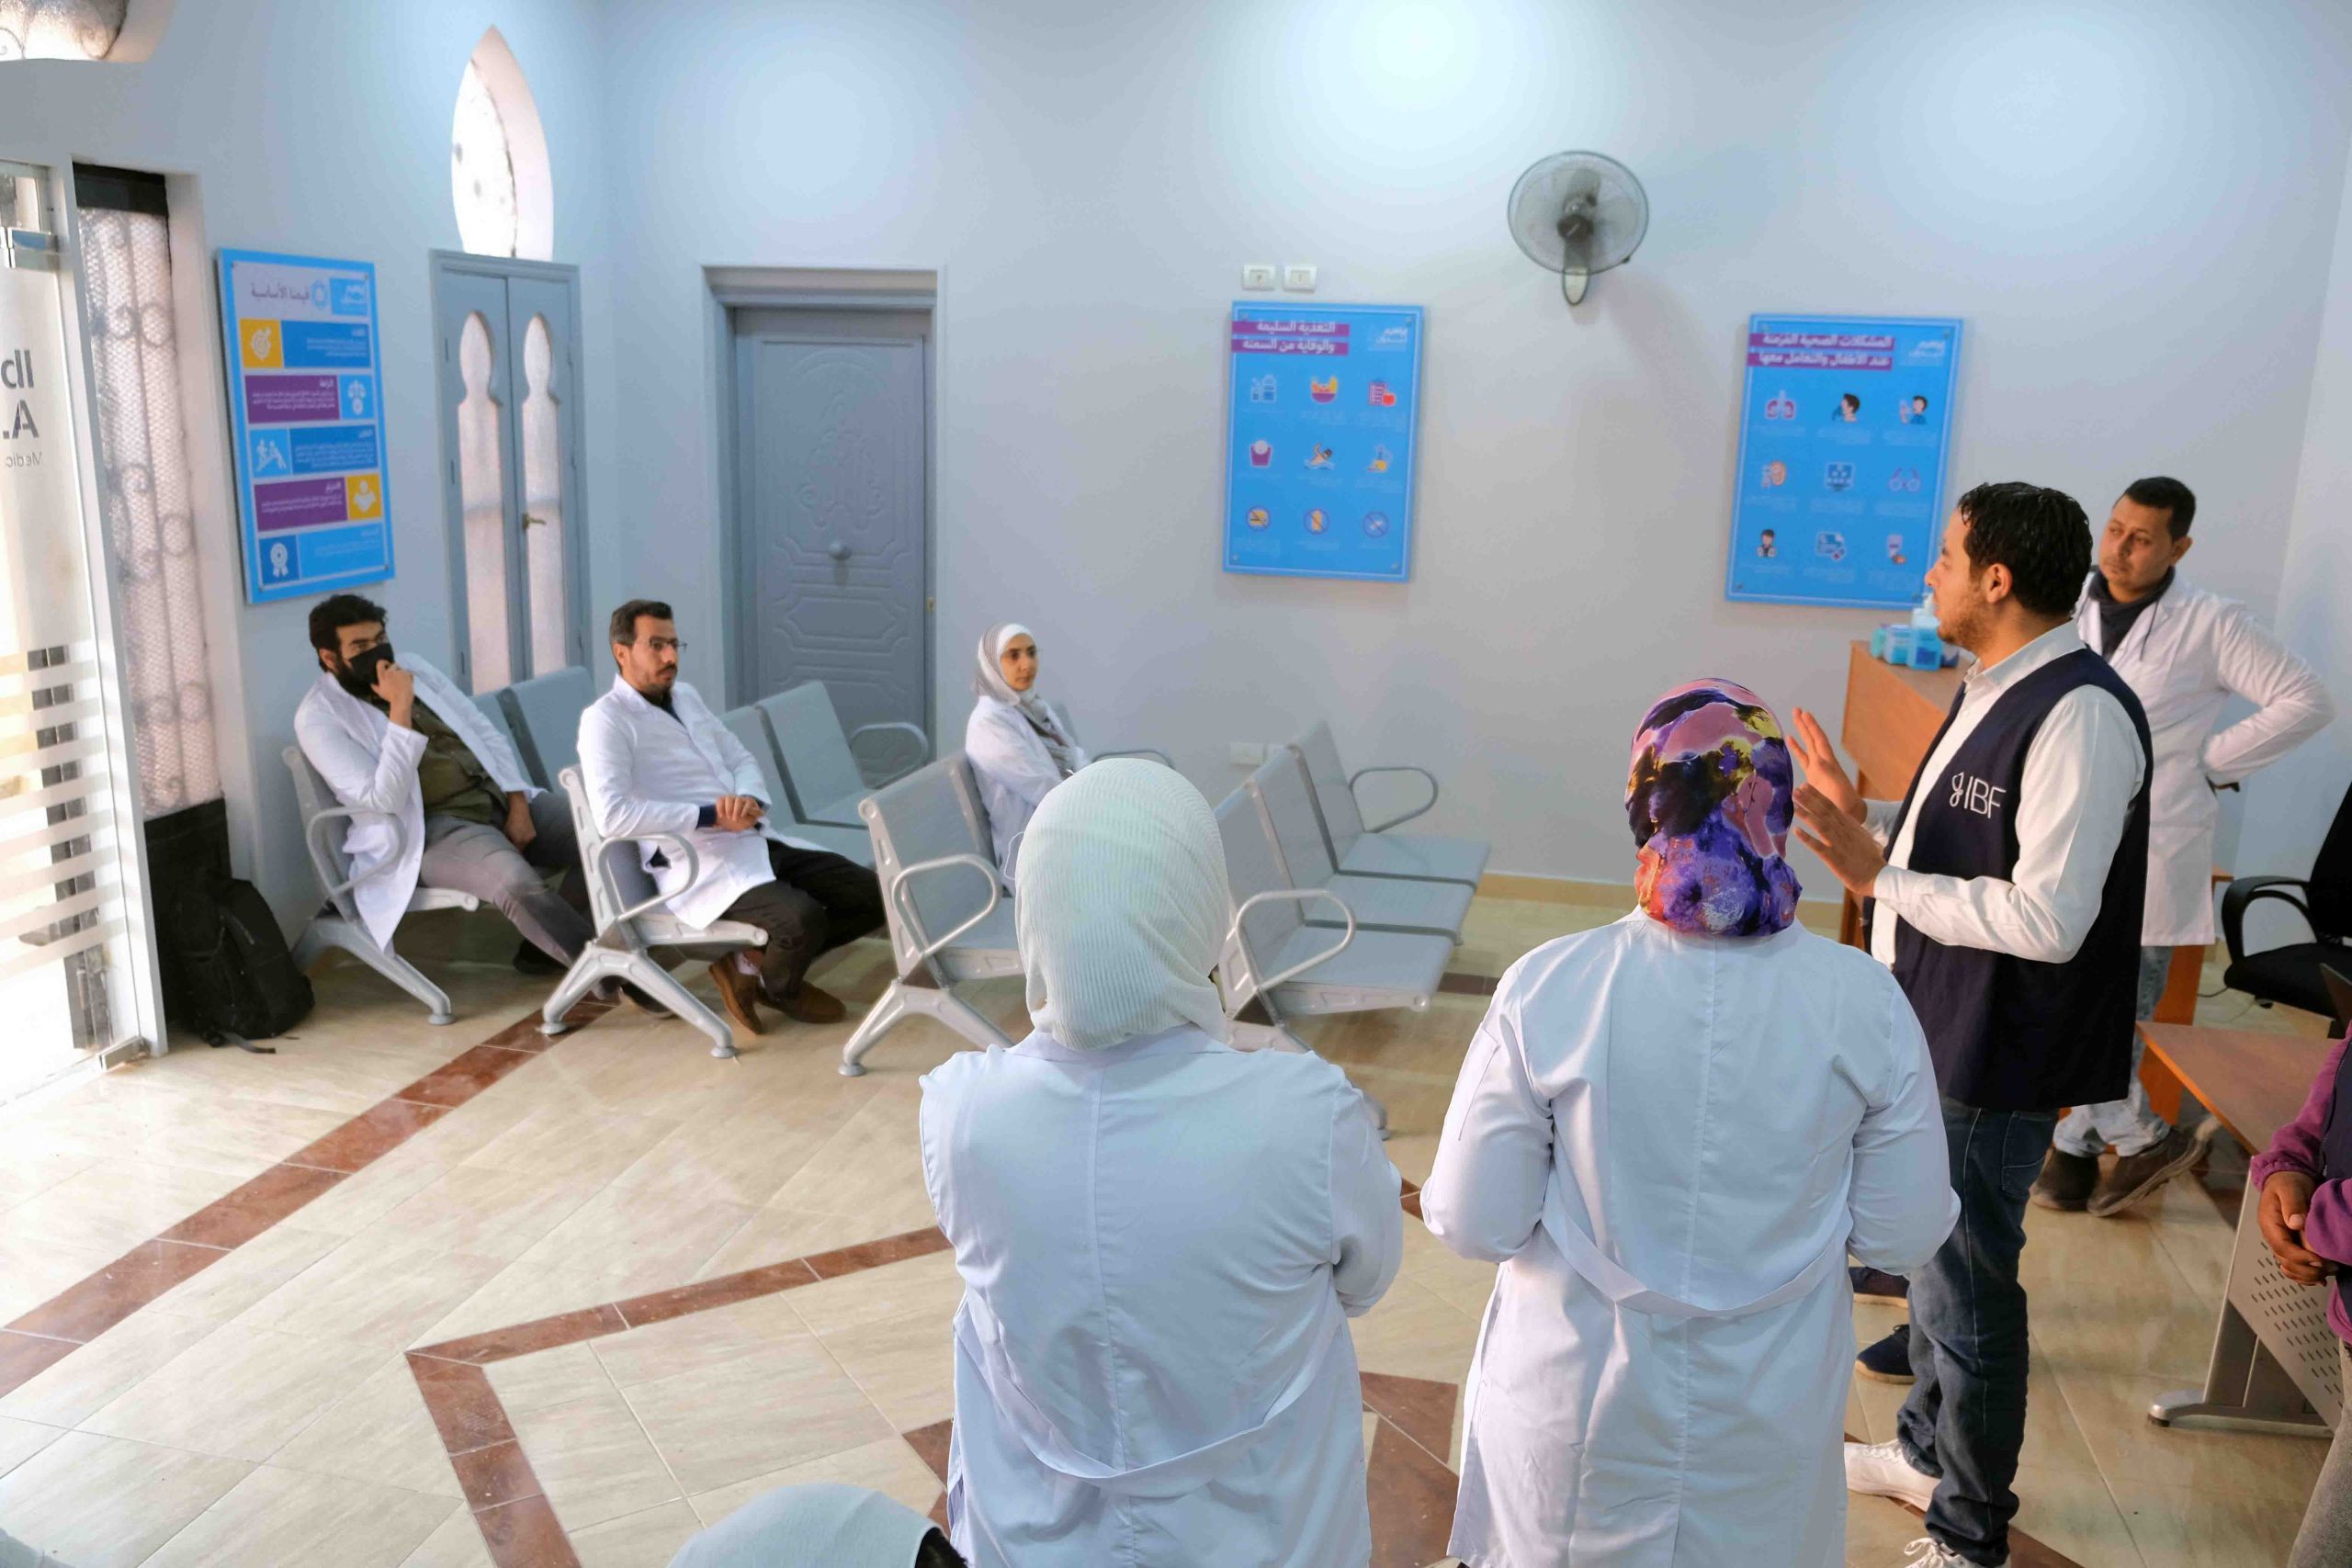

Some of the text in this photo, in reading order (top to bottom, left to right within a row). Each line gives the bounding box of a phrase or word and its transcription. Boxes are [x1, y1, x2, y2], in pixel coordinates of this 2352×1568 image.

[250, 281, 310, 305] قيمنا الأساسية
[1257, 319, 1336, 335] التغذية السليمة
[1242, 336, 1335, 354] والوقاية من السمنة
